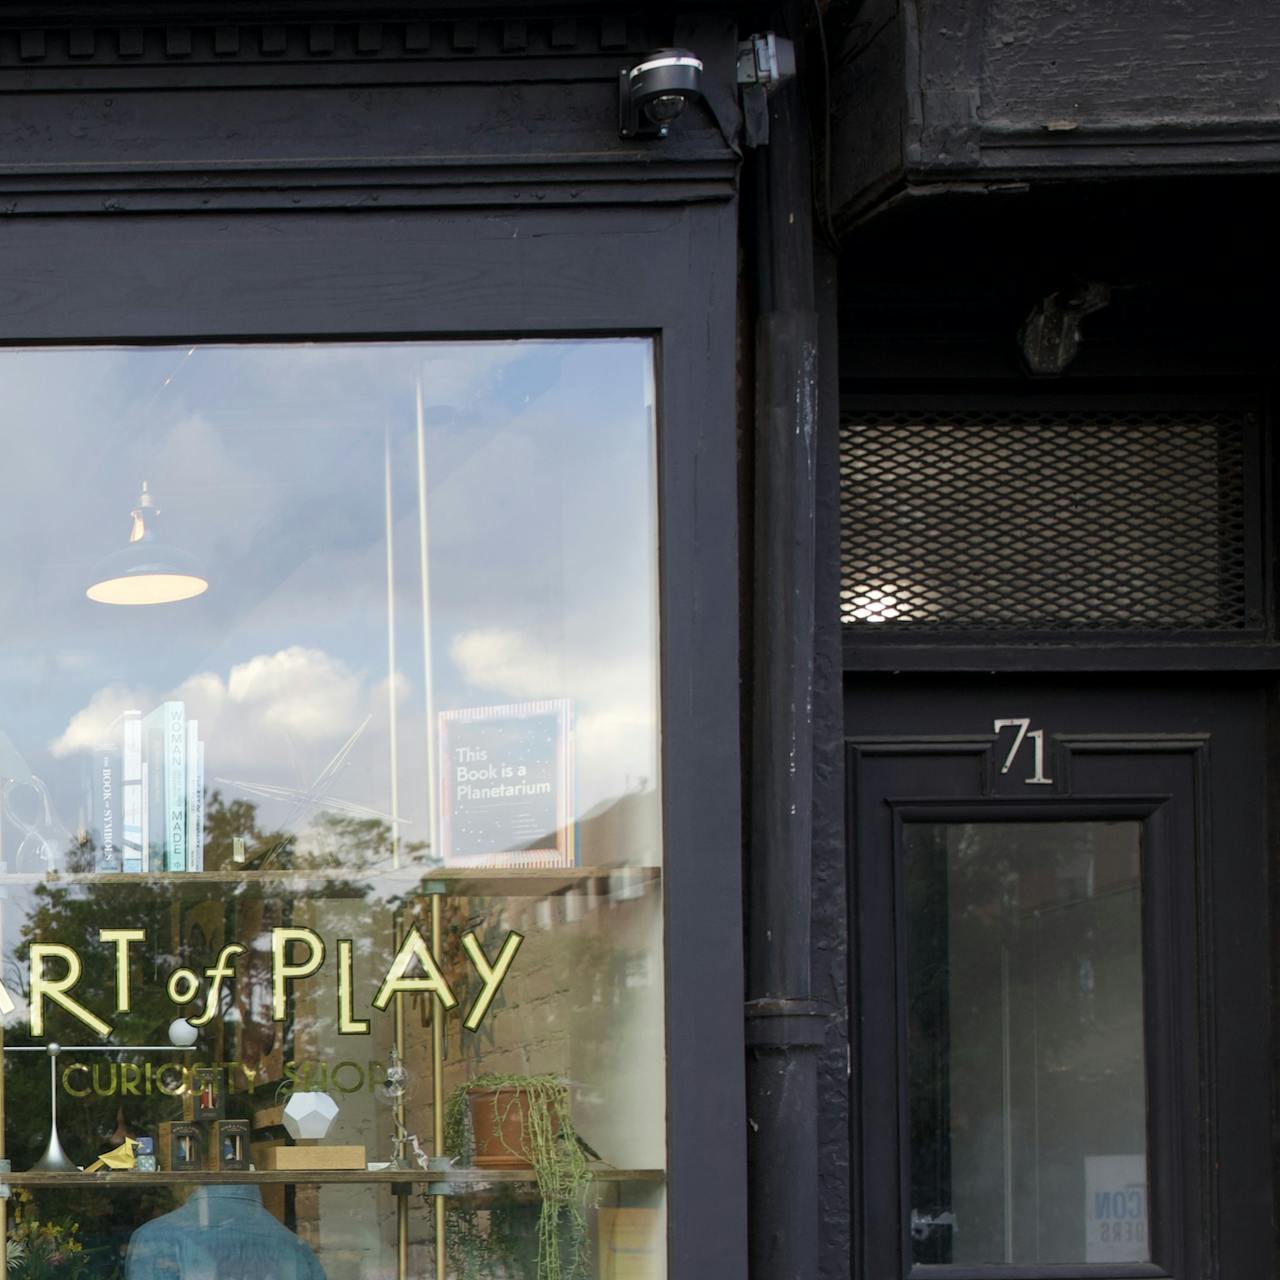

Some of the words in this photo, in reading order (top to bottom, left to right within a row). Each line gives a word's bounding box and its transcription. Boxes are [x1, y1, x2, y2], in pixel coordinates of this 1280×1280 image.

[170, 710, 183, 766] WOMAN
[455, 746, 488, 763] This
[993, 717, 1054, 786] 71
[102, 768, 113, 804] BOOK
[456, 764, 499, 782] Book
[501, 762, 513, 779] is
[516, 765, 528, 777] a
[456, 780, 552, 801] Planetarium
[102, 809, 114, 863] SYMBOLS
[172, 810, 184, 855] MADE
[166, 943, 248, 1028] of
[271, 925, 526, 1036] PLAY
[61, 1060, 259, 1098] CURIOSITY
[280, 1060, 391, 1096] SHOP
